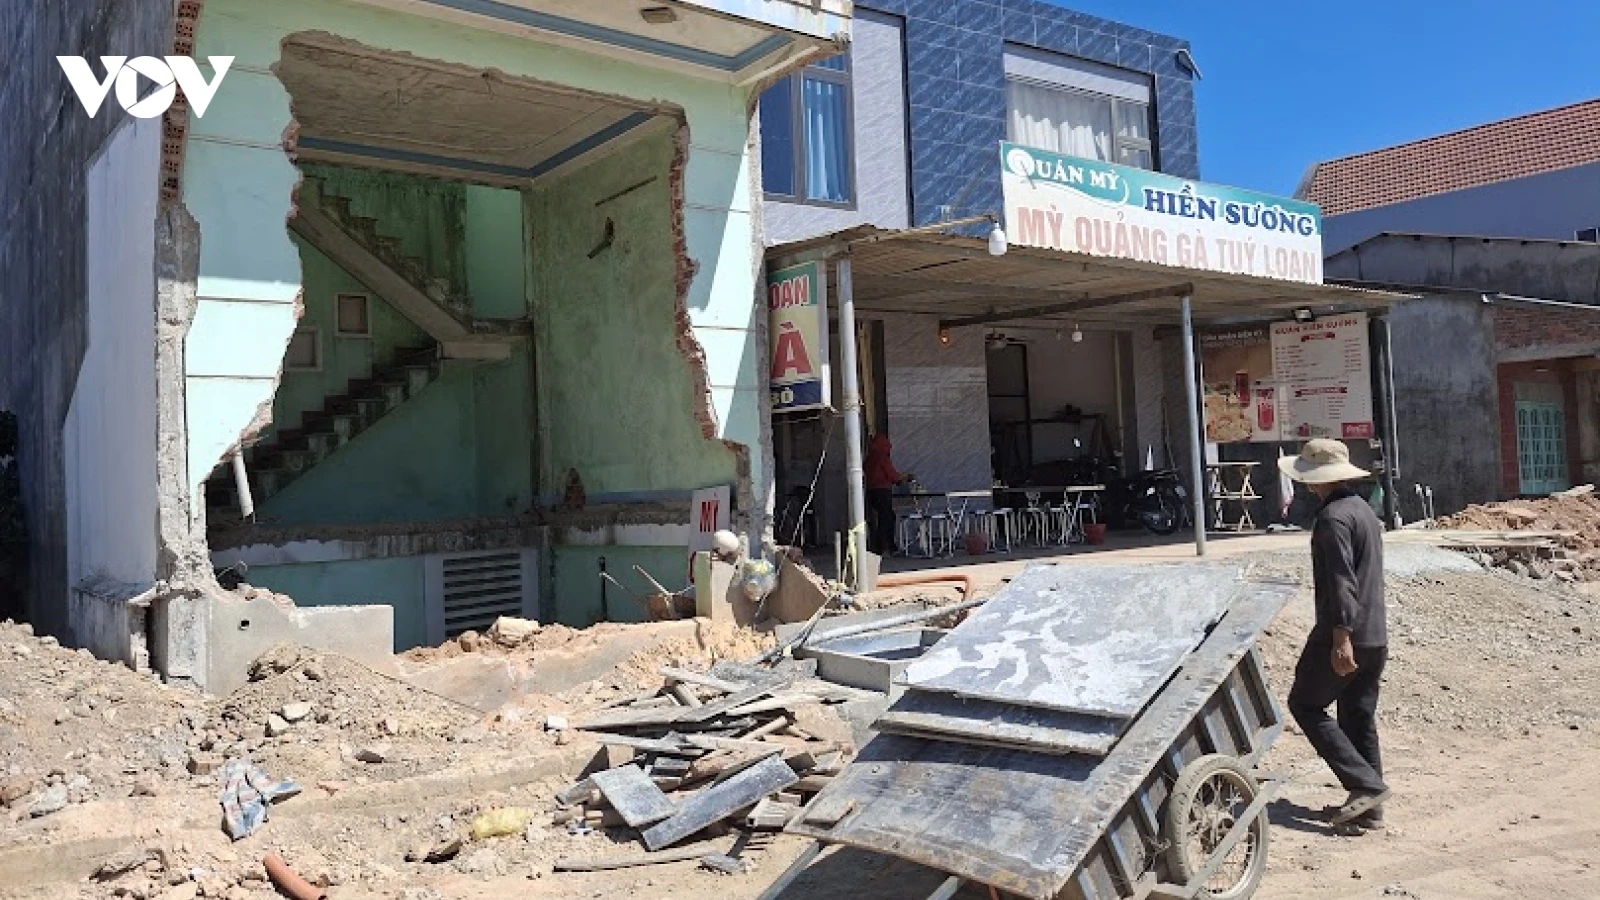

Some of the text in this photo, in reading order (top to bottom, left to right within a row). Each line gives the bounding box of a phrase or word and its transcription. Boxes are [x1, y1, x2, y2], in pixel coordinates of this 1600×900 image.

[1006, 148, 1084, 187] QUÁN
[1143, 184, 1314, 236] HIỀN SƯƠNG
[1075, 210, 1168, 265] QUẢNG
[1176, 229, 1209, 269] GÀ
[1263, 244, 1316, 281] LOAN
[768, 275, 810, 309] OAN
[772, 321, 813, 378] À
